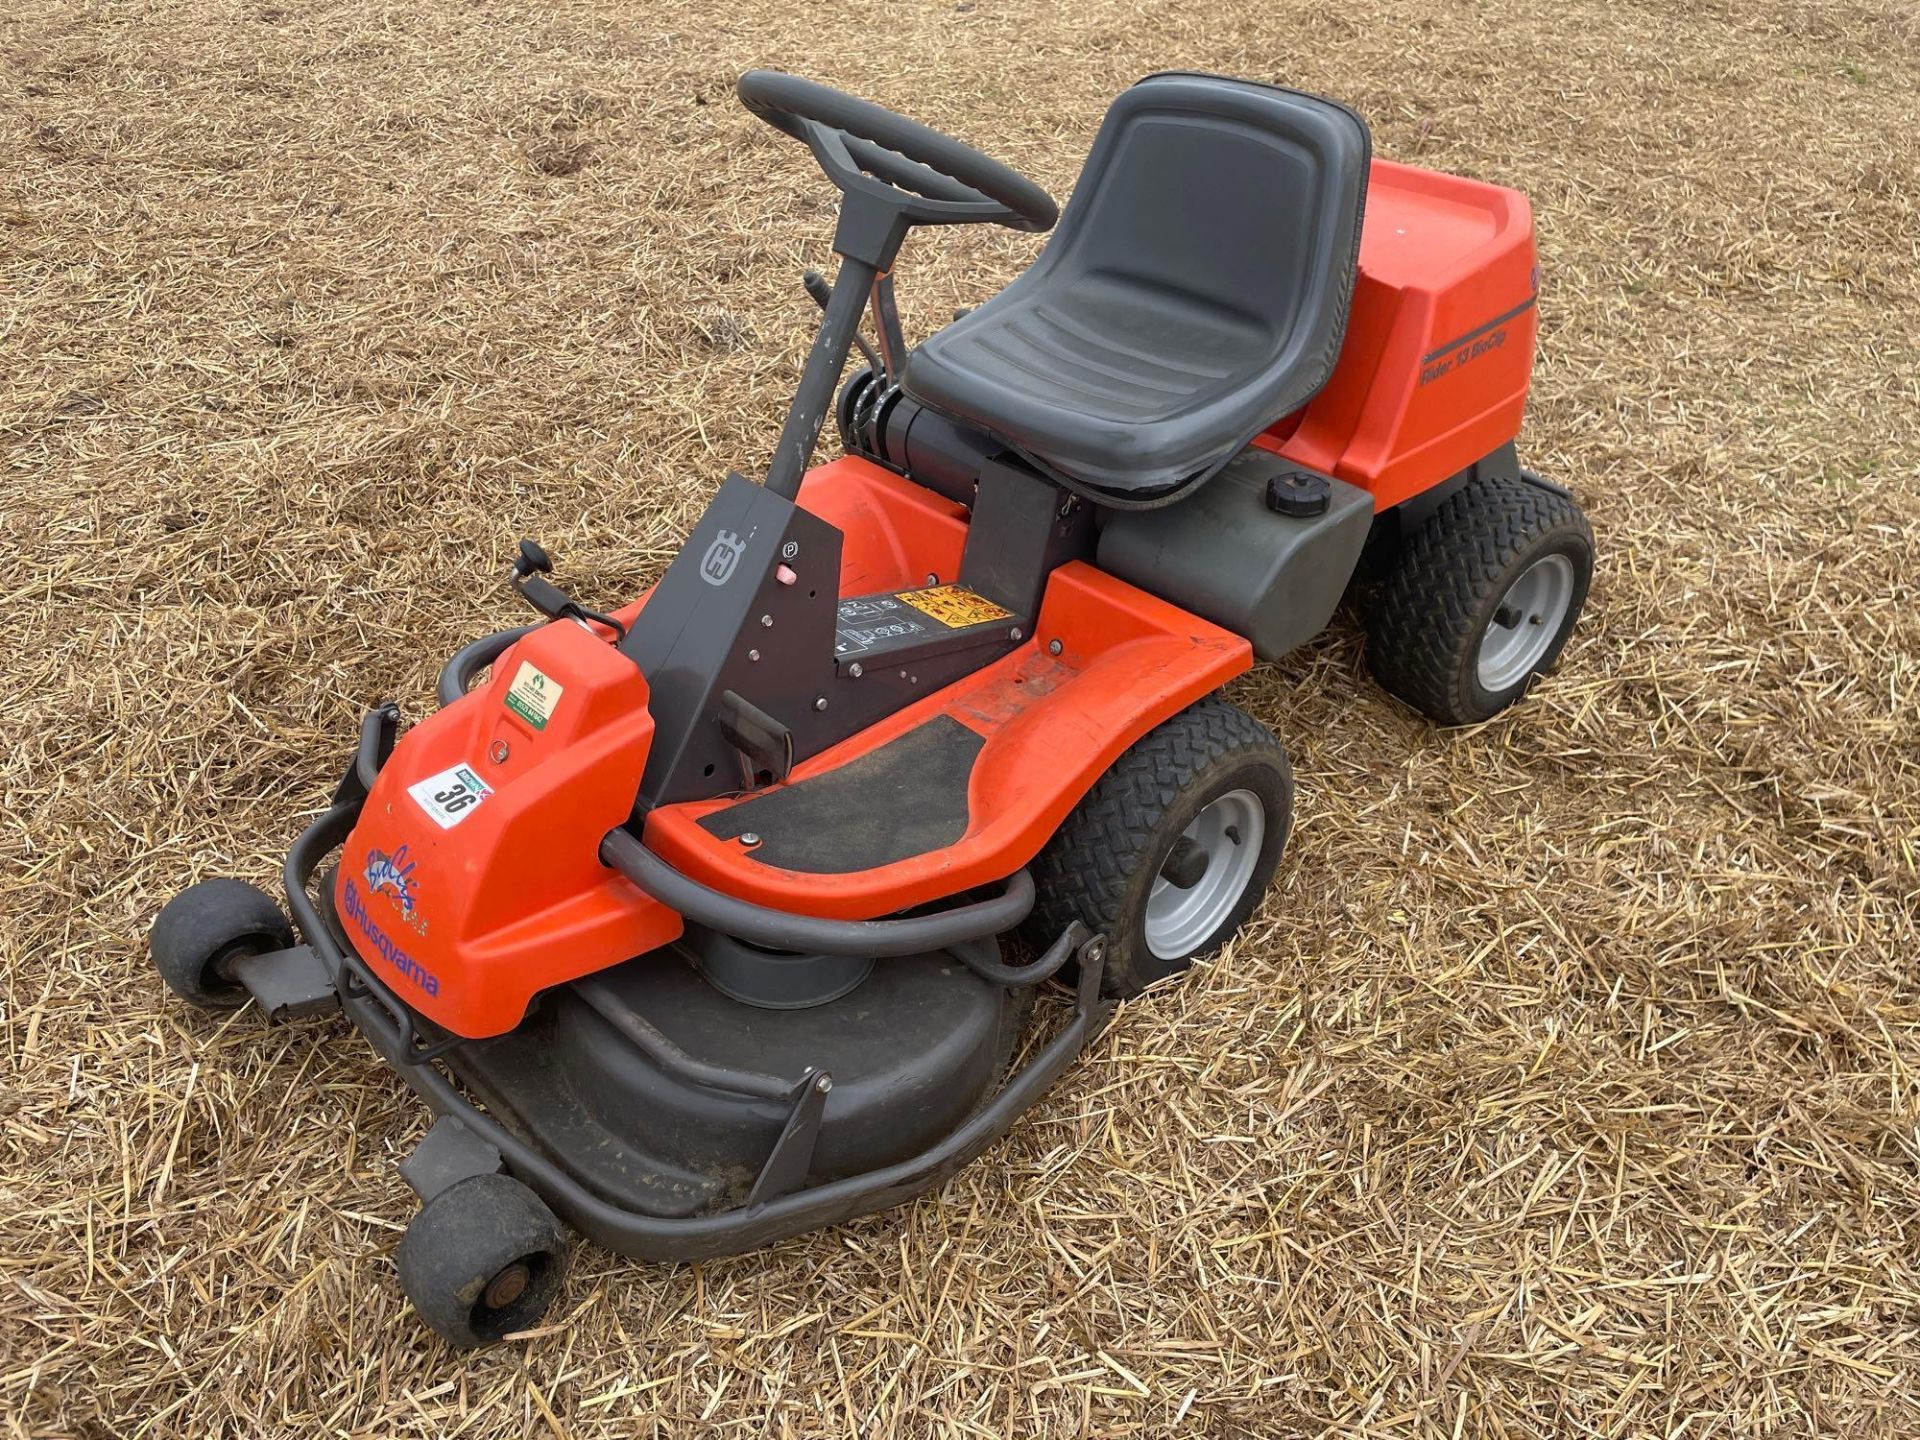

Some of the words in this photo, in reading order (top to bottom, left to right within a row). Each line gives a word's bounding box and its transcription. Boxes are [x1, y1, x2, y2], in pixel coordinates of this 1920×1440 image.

[1420, 359, 1452, 385] Rider
[1456, 346, 1469, 367] 13
[1472, 331, 1506, 358] BioClip
[434, 783, 477, 813] 36
[351, 902, 439, 997] Husqvarna
